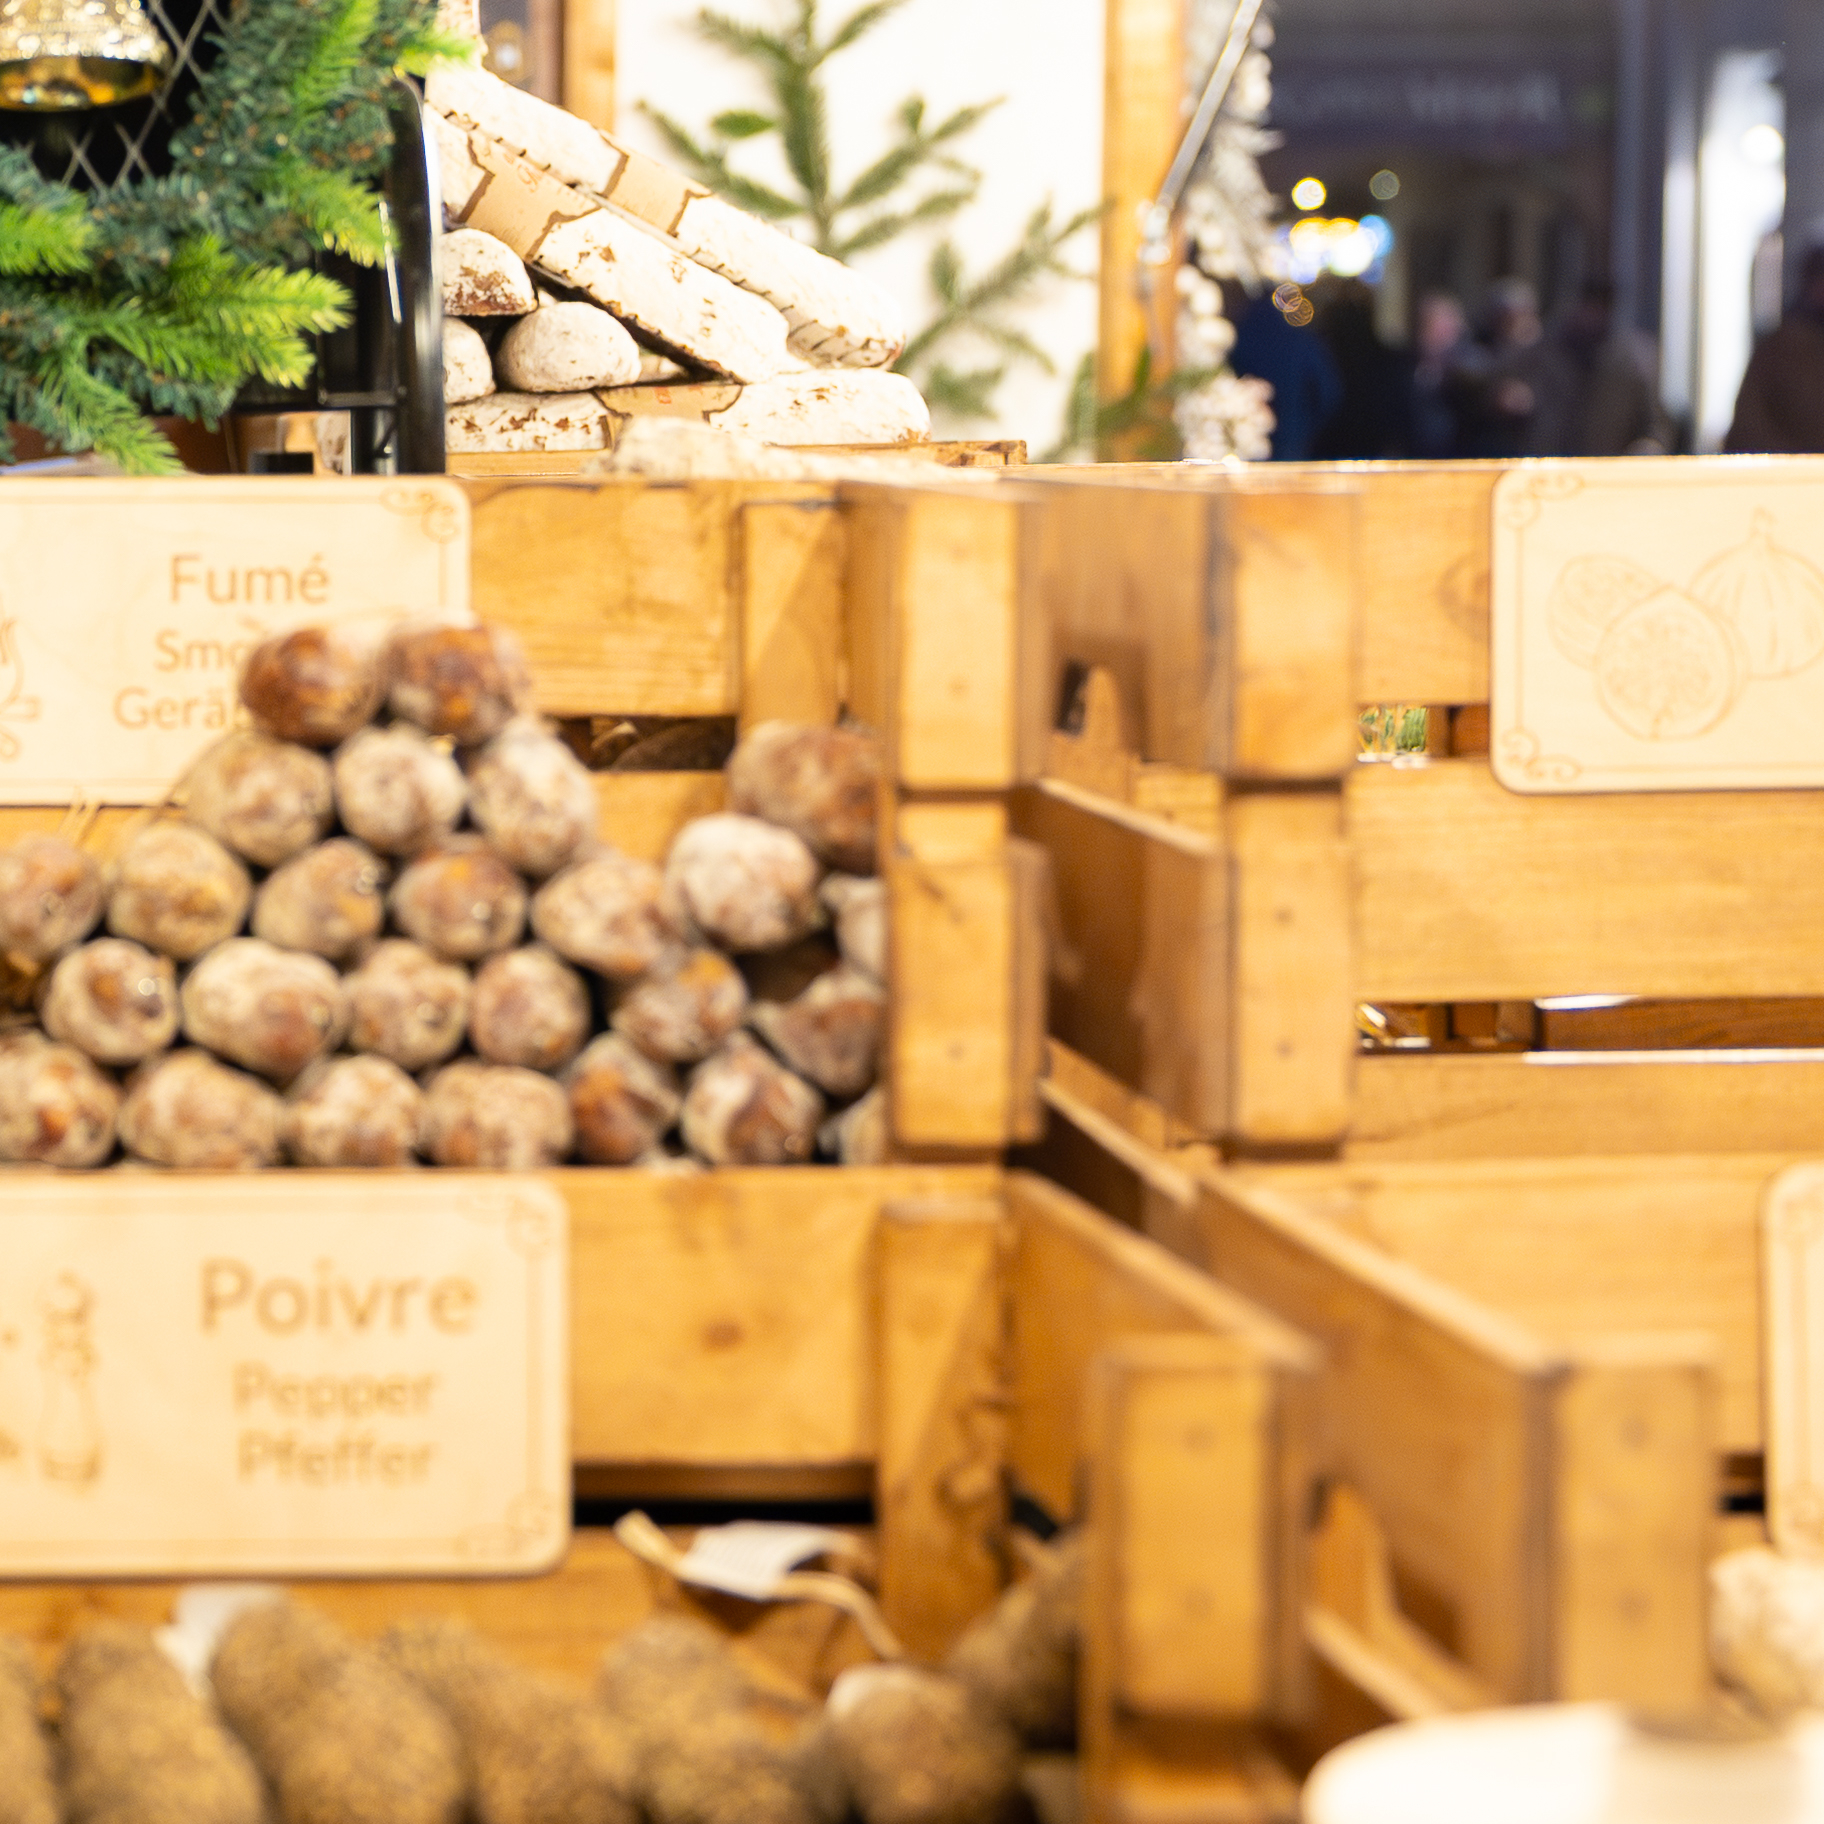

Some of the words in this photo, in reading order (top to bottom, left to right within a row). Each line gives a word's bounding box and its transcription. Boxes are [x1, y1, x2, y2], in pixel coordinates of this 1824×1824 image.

[169, 551, 330, 605] Fumé
[153, 628, 248, 673] Smo
[112, 686, 244, 731] Gerä
[198, 1255, 480, 1338] Poivre
[231, 1363, 438, 1420] Pepper
[235, 1427, 436, 1487] Pfeffer
